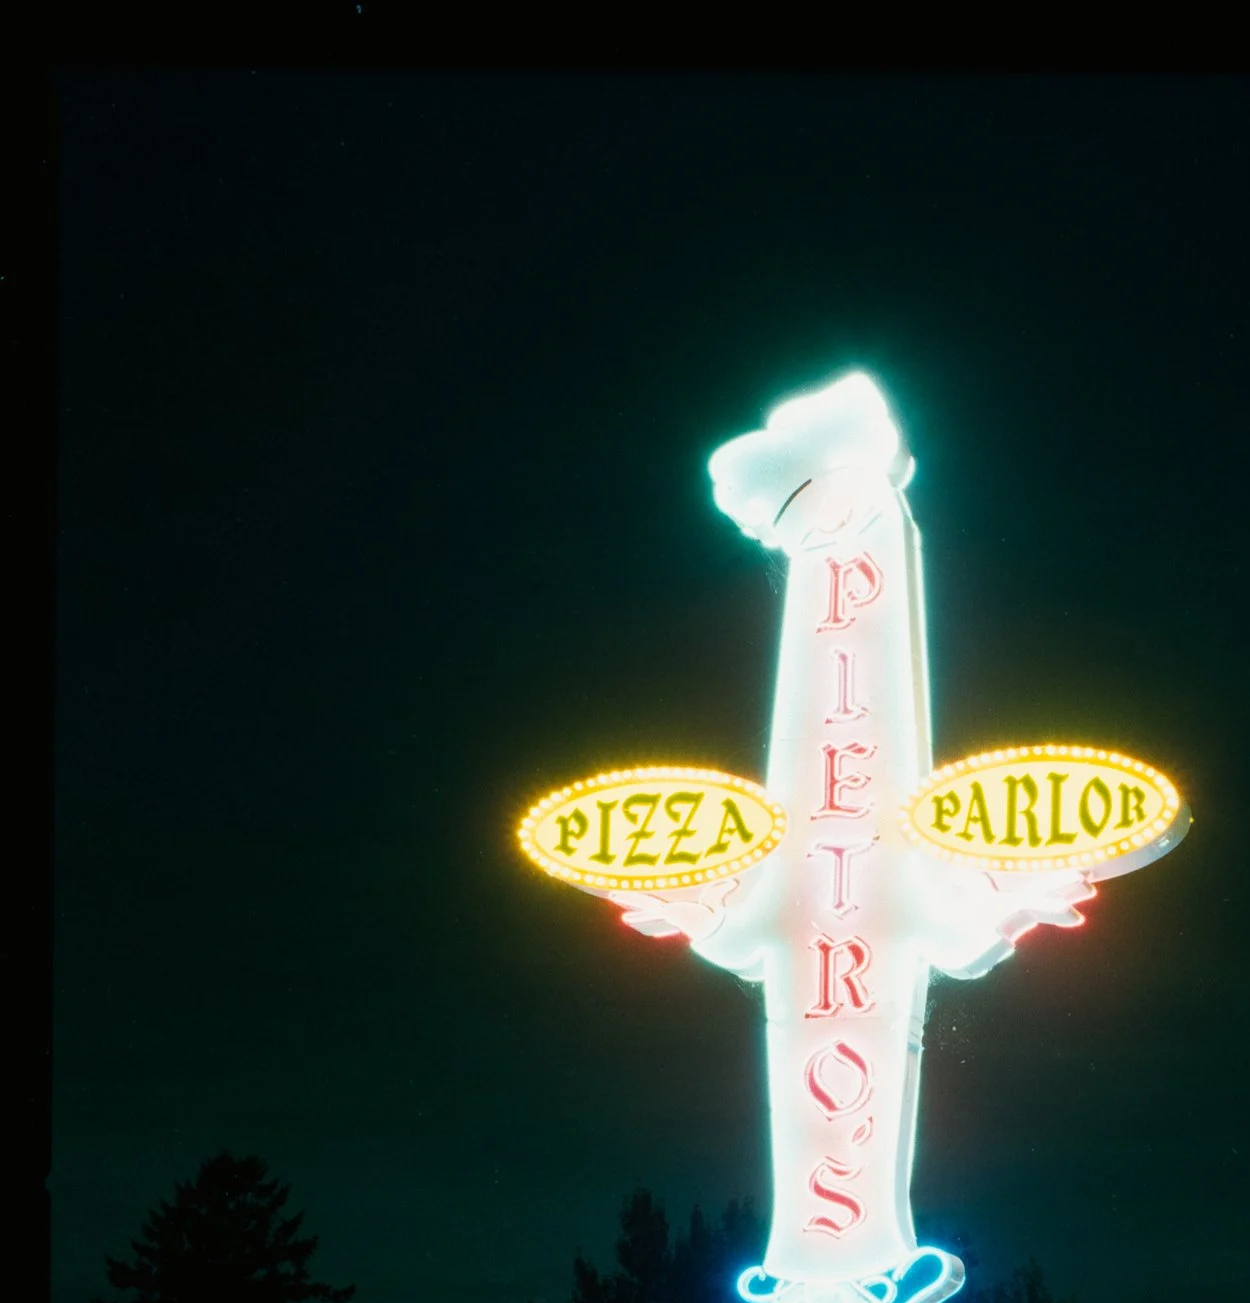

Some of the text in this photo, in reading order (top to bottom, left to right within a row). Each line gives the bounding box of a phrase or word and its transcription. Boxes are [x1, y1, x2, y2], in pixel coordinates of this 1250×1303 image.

[554, 792, 754, 867] PIZZA
[931, 772, 1148, 848] PARLOR
[802, 551, 884, 1240] PIETRO'S
